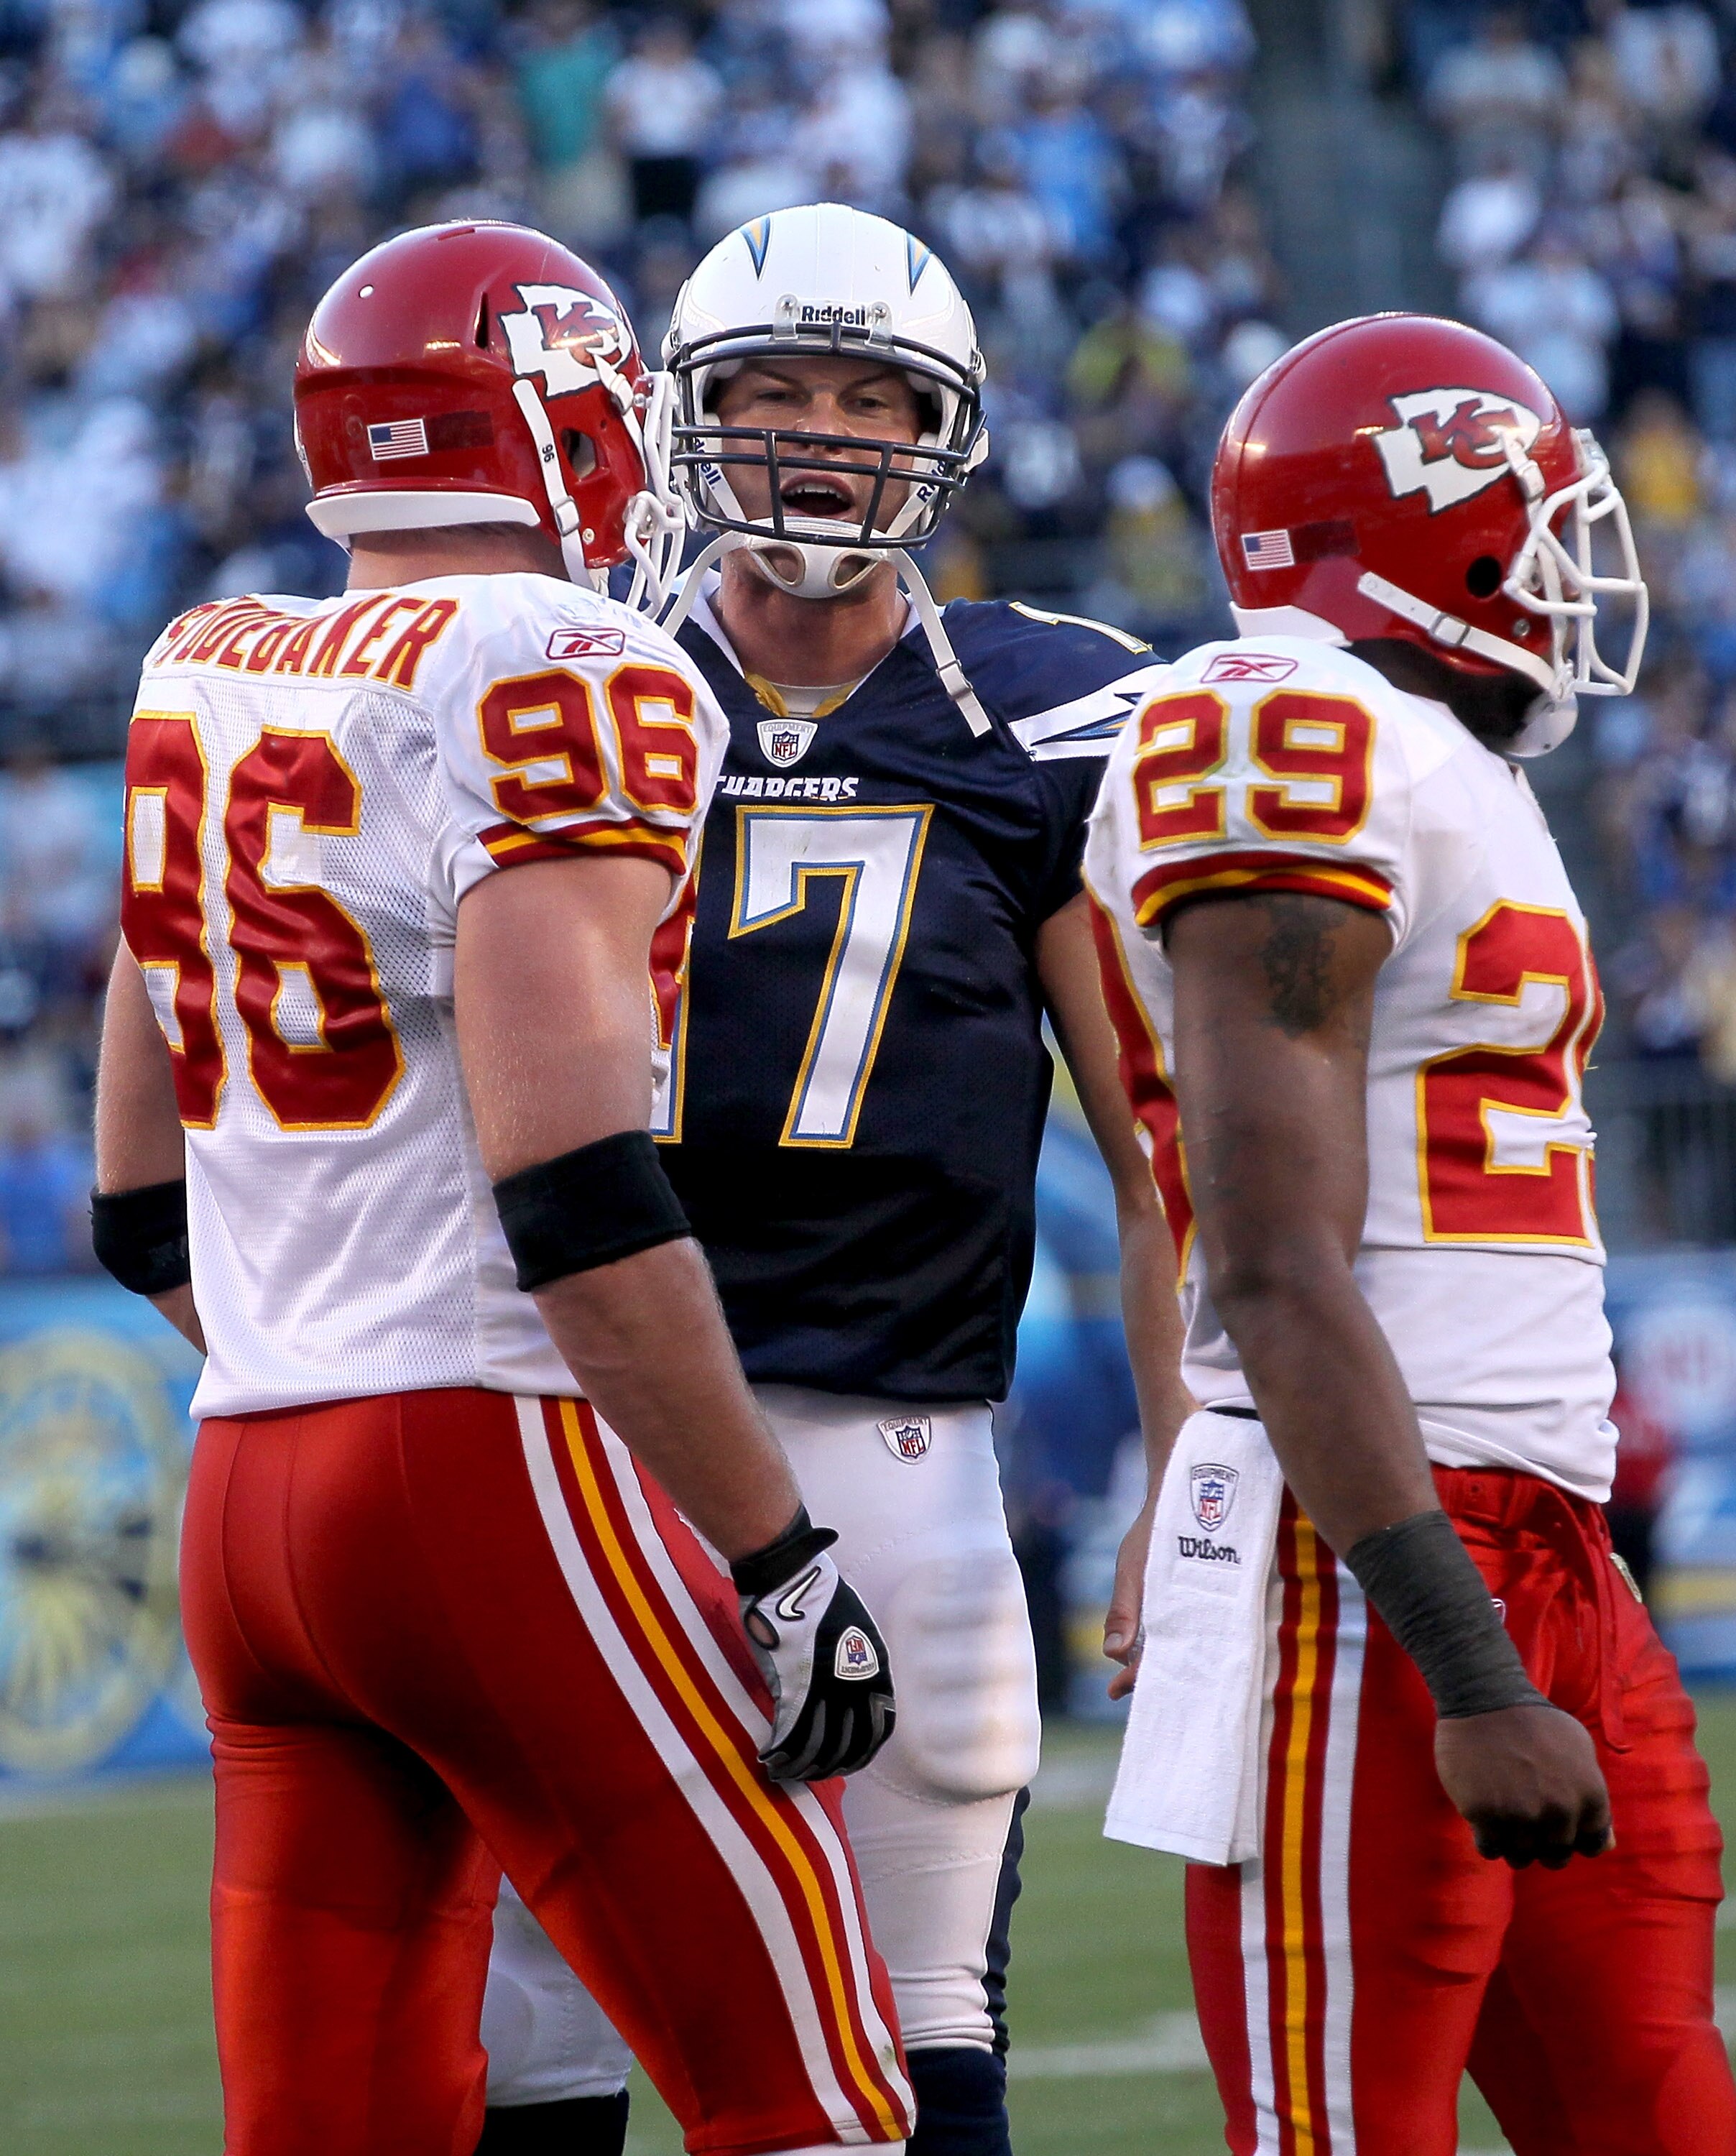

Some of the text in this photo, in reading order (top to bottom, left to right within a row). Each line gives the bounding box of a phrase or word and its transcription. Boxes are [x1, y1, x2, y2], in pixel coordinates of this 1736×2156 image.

[801, 305, 866, 326] Riddell
[542, 443, 555, 463] 96
[478, 665, 700, 825] 96
[775, 742, 798, 757] NFL
[1132, 688, 1375, 852] 29
[119, 709, 405, 1130] 96
[901, 1438, 924, 1455] NFL
[1178, 1536, 1241, 1565] Wilson
